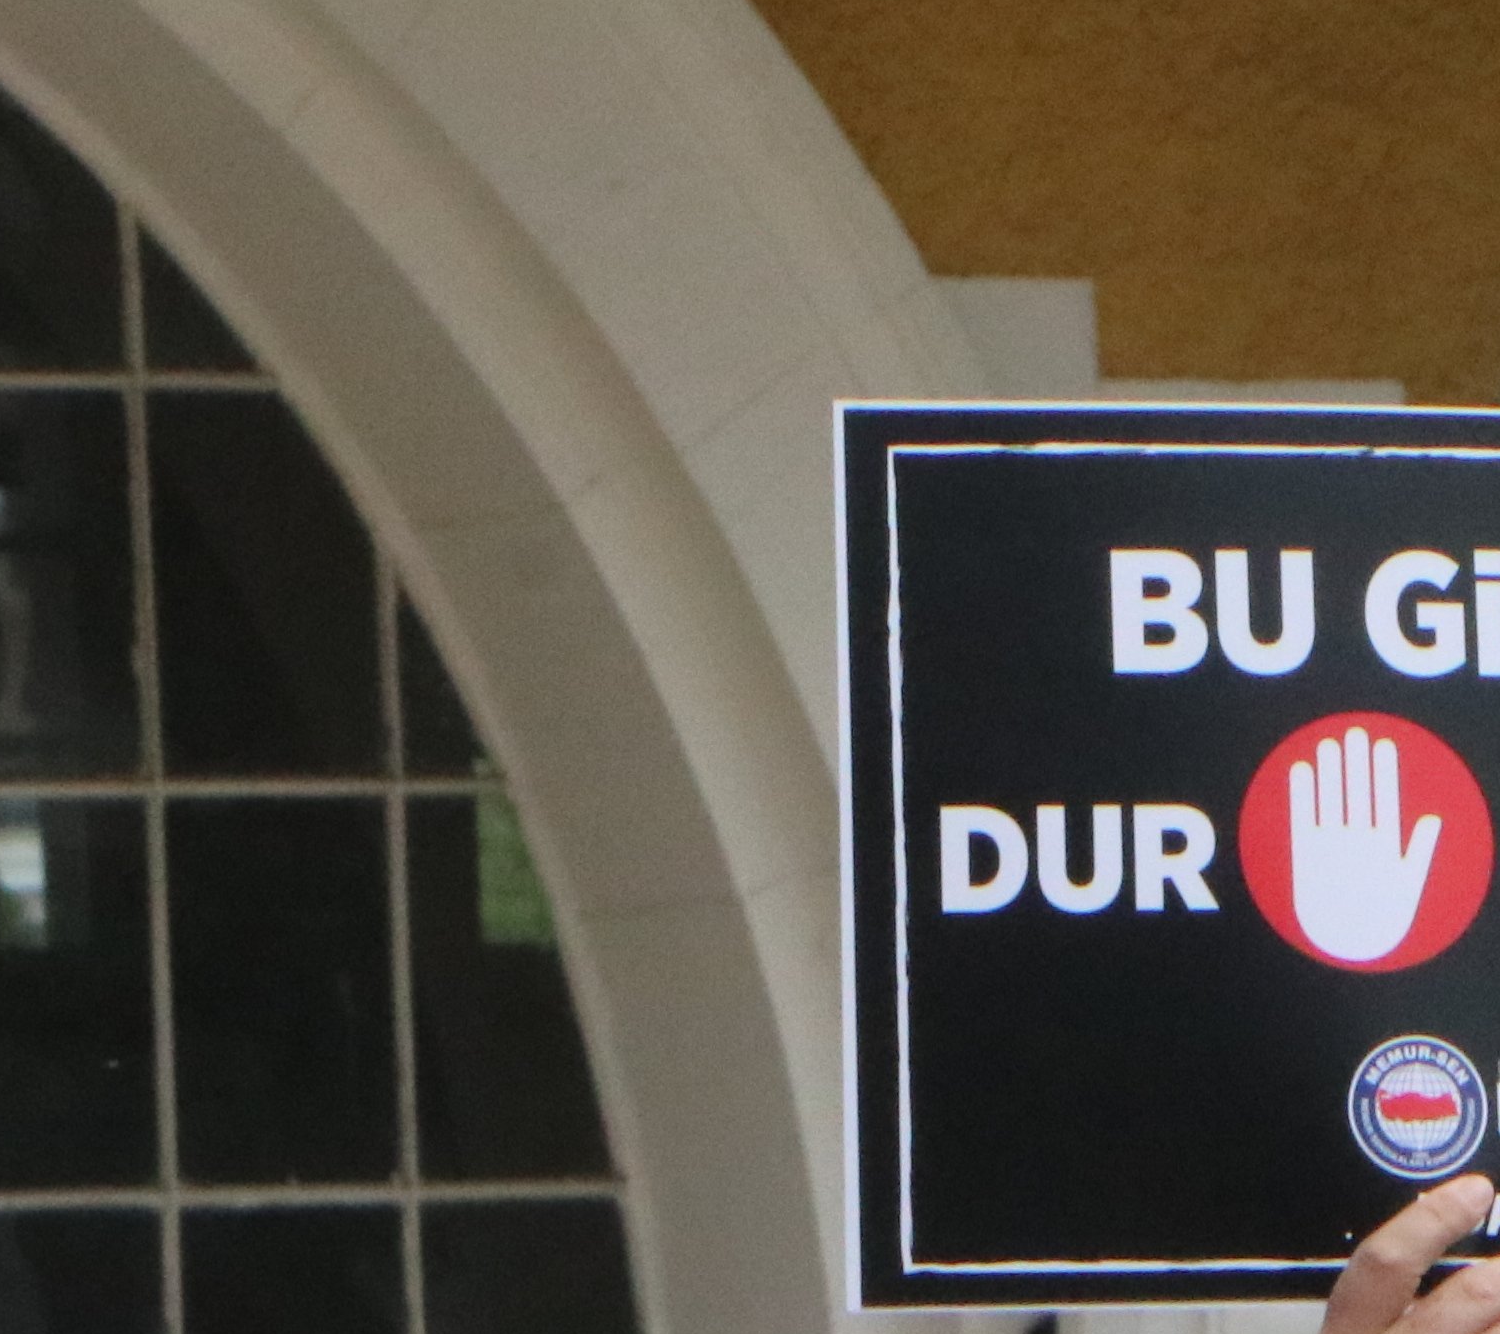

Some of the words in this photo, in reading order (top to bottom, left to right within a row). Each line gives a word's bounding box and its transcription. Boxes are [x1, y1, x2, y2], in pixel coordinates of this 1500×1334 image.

[1109, 548, 1316, 676] BU
[939, 803, 1220, 914] DUR
[1364, 1043, 1472, 1086] MEMUR-SEN
